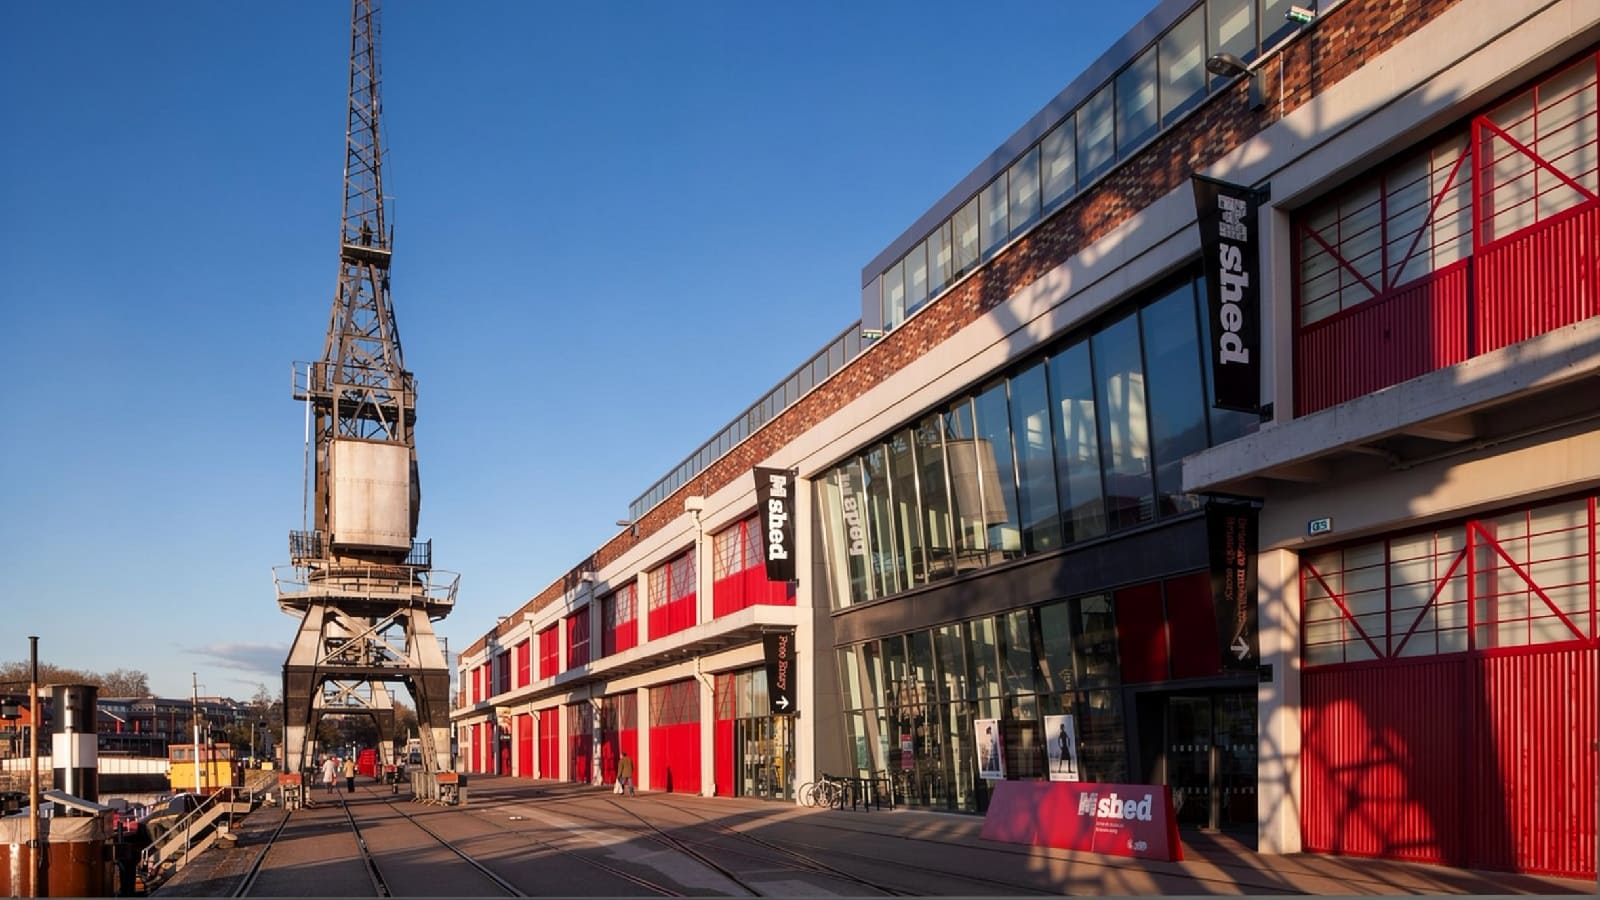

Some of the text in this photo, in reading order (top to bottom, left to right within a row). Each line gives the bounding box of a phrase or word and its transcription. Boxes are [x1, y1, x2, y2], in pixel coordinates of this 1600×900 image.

[1218, 194, 1249, 365] M shed
[769, 474, 787, 560] M shed
[776, 635, 788, 690] Free Entry
[1078, 791, 1153, 821] M shed
